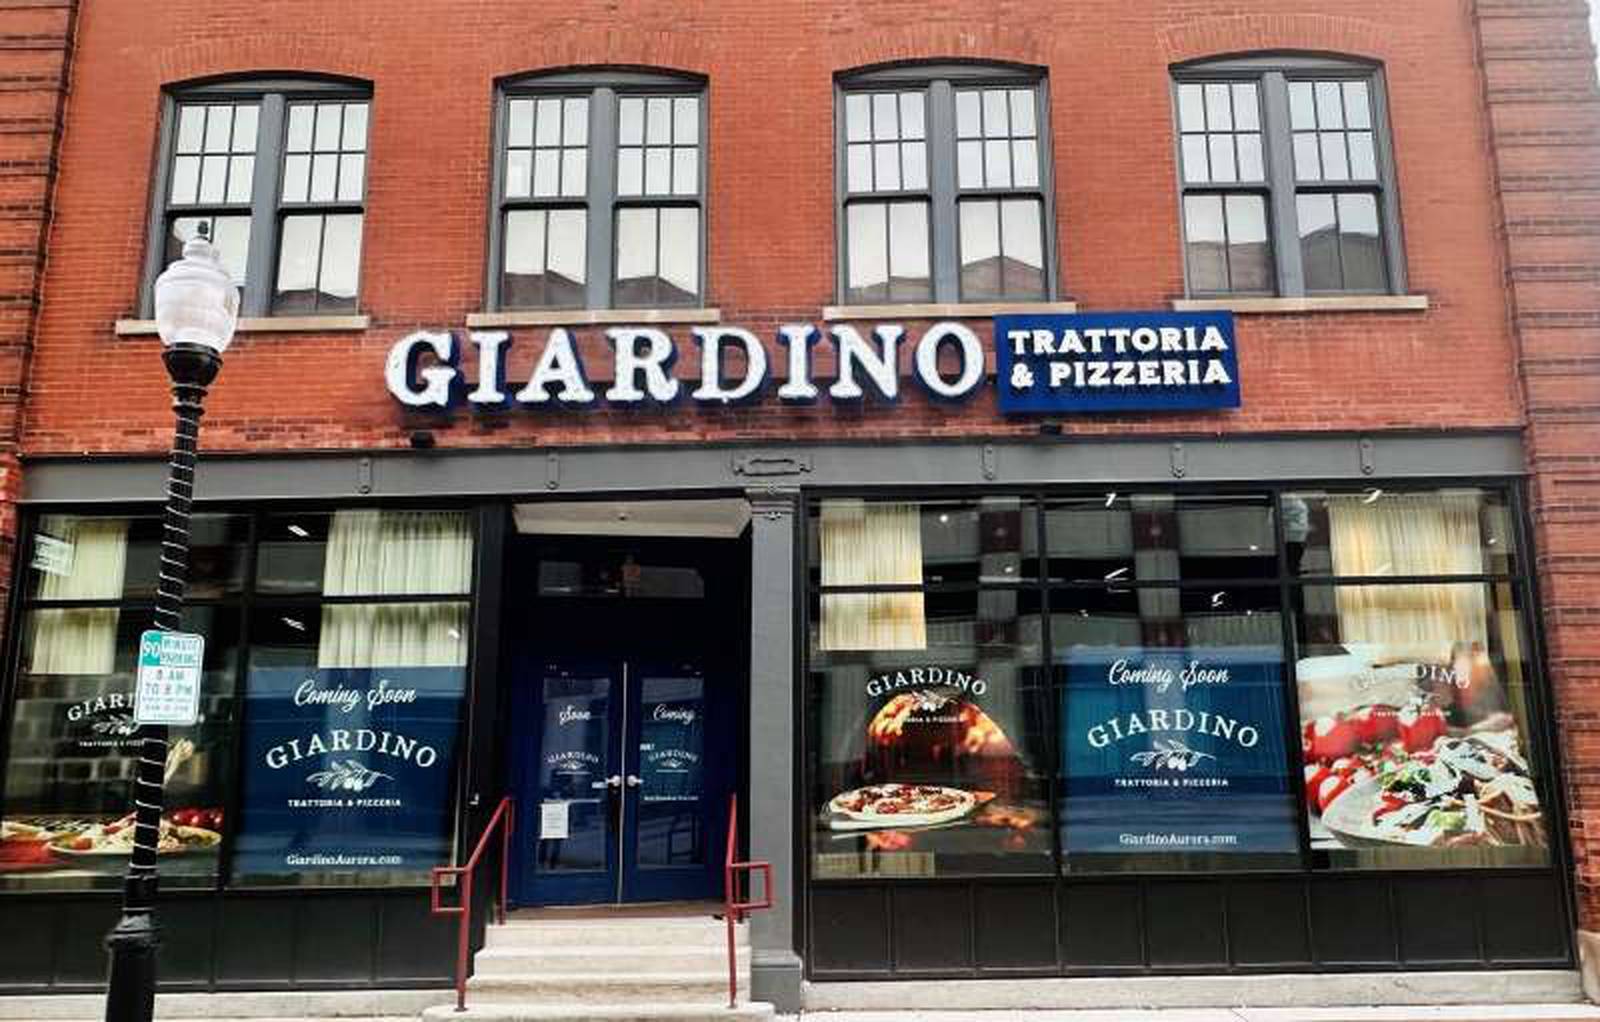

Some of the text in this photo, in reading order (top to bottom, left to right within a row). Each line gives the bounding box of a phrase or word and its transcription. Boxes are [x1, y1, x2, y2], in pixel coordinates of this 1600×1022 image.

[1008, 326, 1228, 354] TRATTORIA
[384, 322, 985, 407] GIARDINO
[1011, 359, 1232, 388] & PIZZERIA
[866, 667, 987, 697] GIARDINO
[1109, 659, 1229, 693] Coming Soon
[294, 679, 416, 712] Coming Soon
[559, 705, 591, 725] Soon
[653, 704, 695, 725] Coming
[1088, 709, 1259, 747] GIARDINO
[266, 729, 436, 769] GIARDINO
[1115, 779, 1169, 787] TRATTORIA
[1183, 779, 1229, 787] PIZZERIA
[288, 799, 343, 807] TRATTORIA
[357, 799, 401, 807] PIZZERIA
